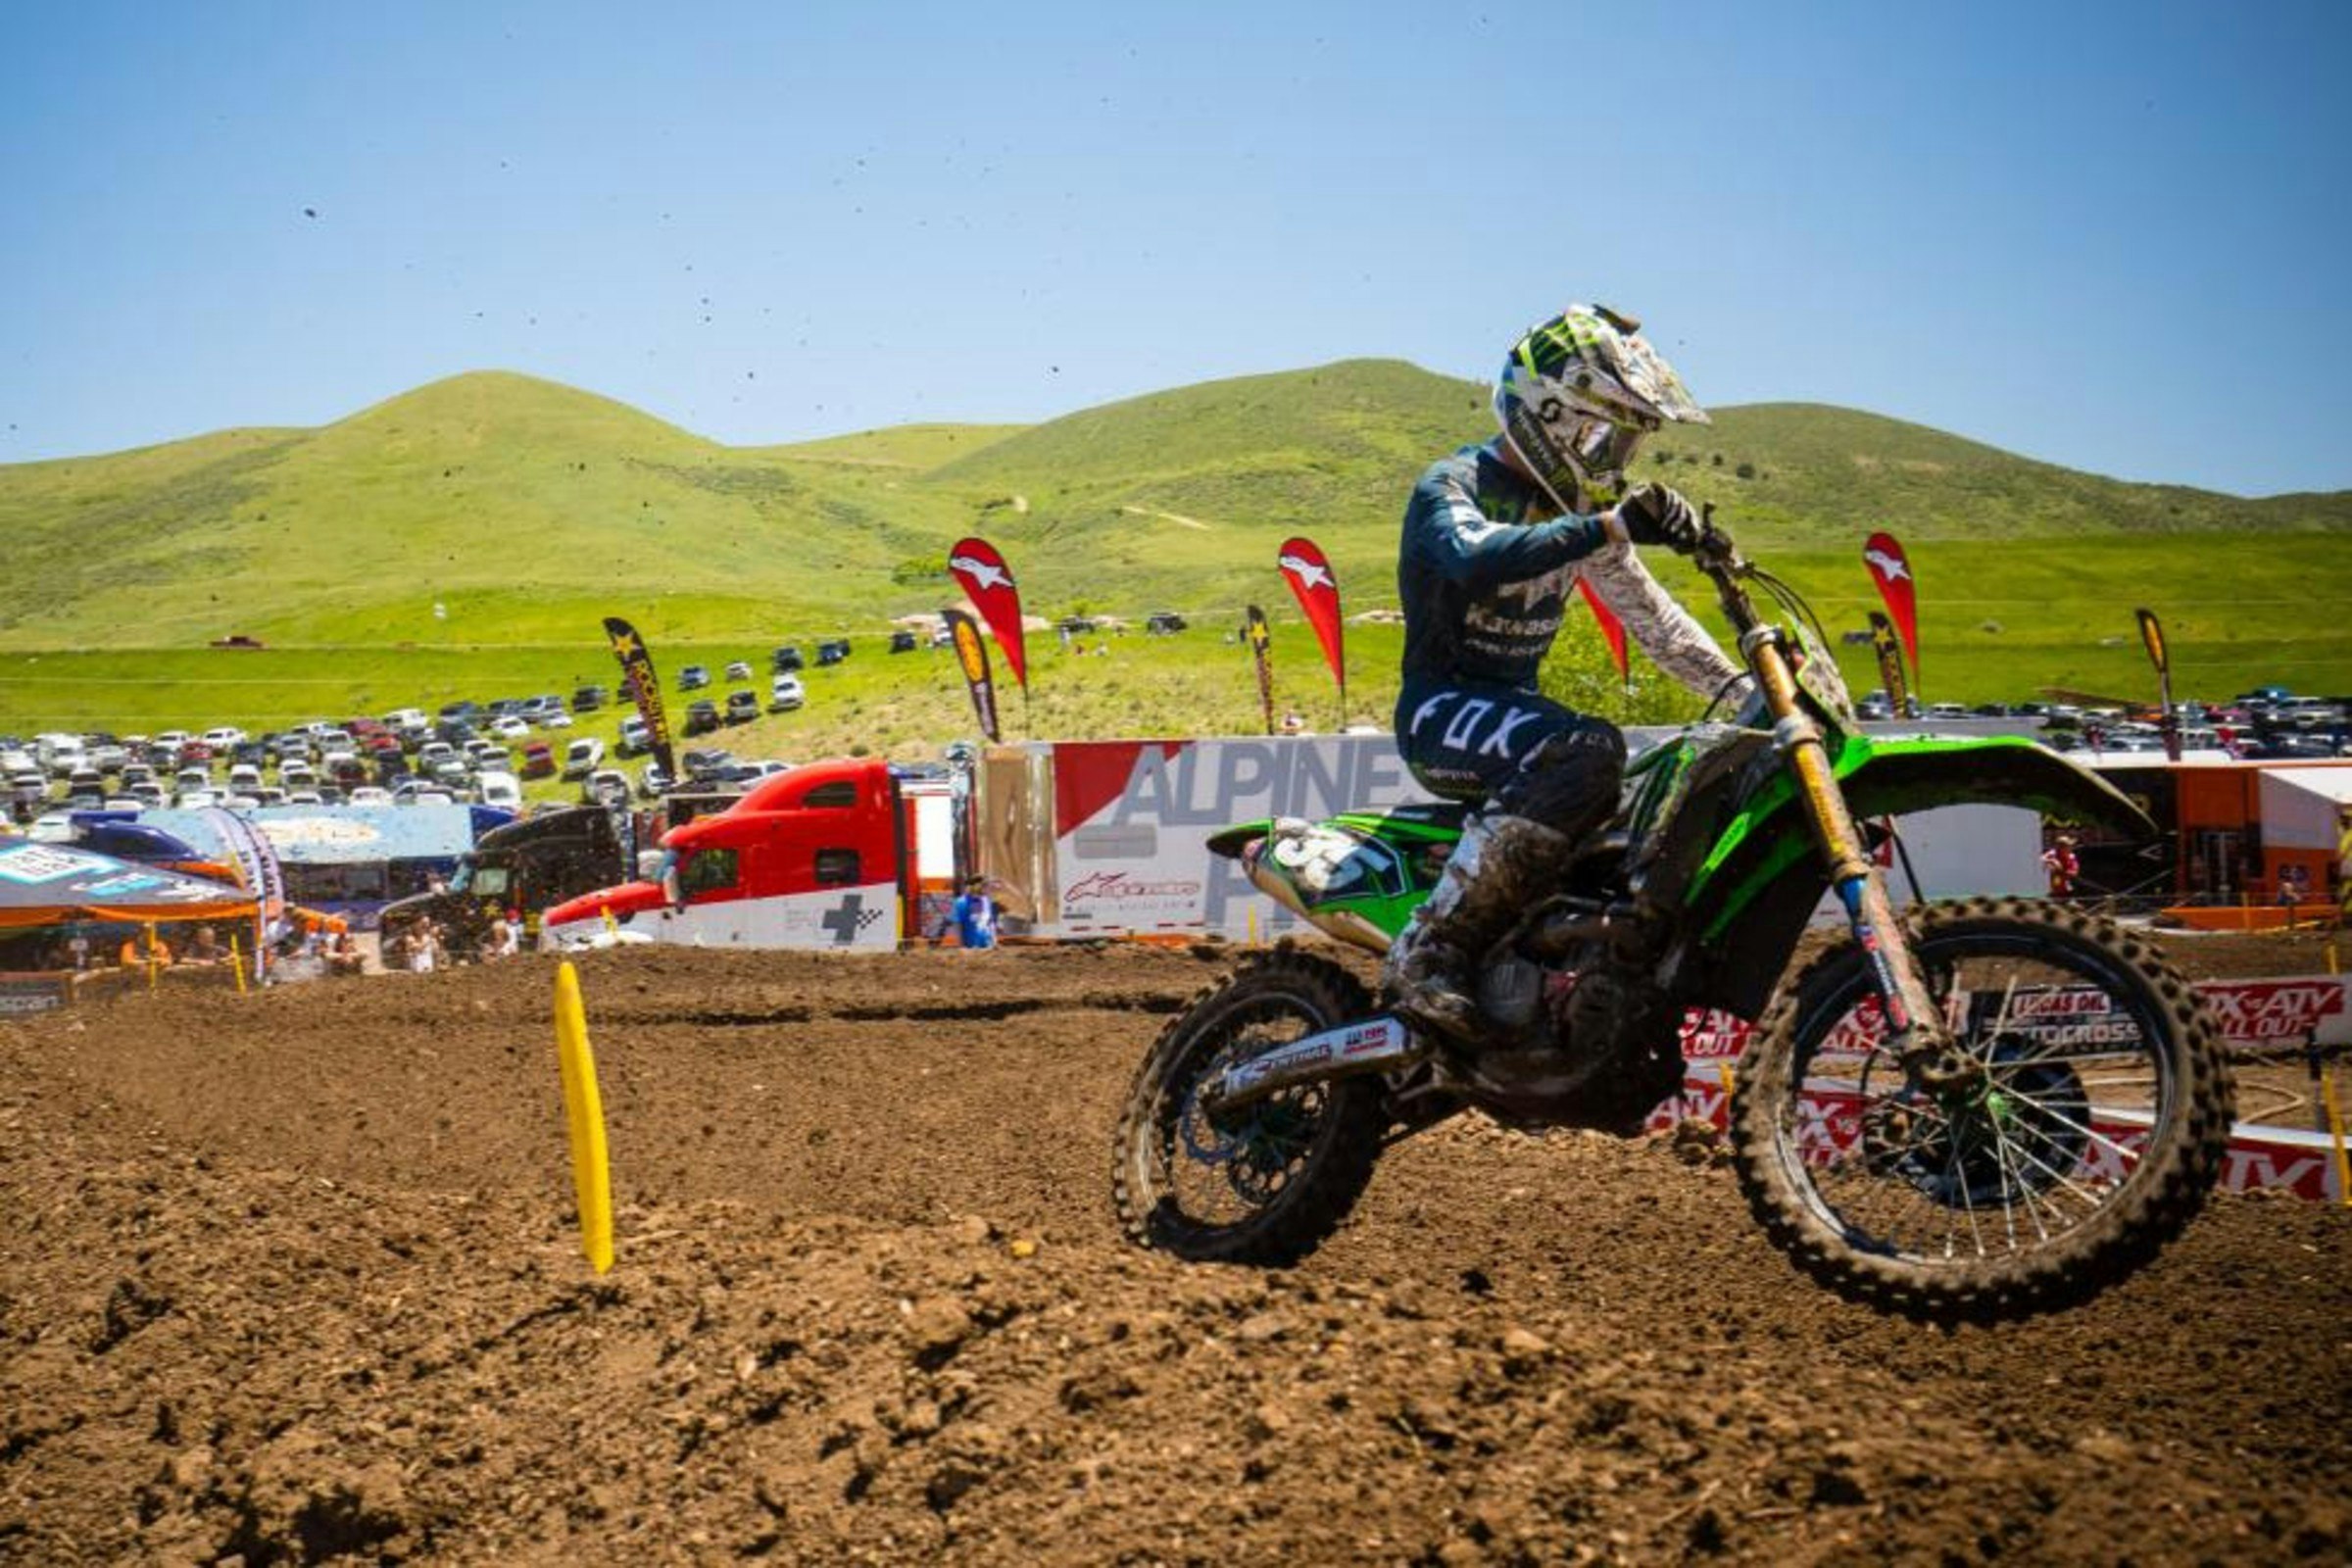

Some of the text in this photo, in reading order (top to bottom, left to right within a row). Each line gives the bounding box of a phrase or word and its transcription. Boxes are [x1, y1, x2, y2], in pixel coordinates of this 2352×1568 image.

[1410, 691, 1543, 760] FOX
[1112, 739, 1418, 826] ALPINE
[2078, 993, 2107, 1011] OIL
